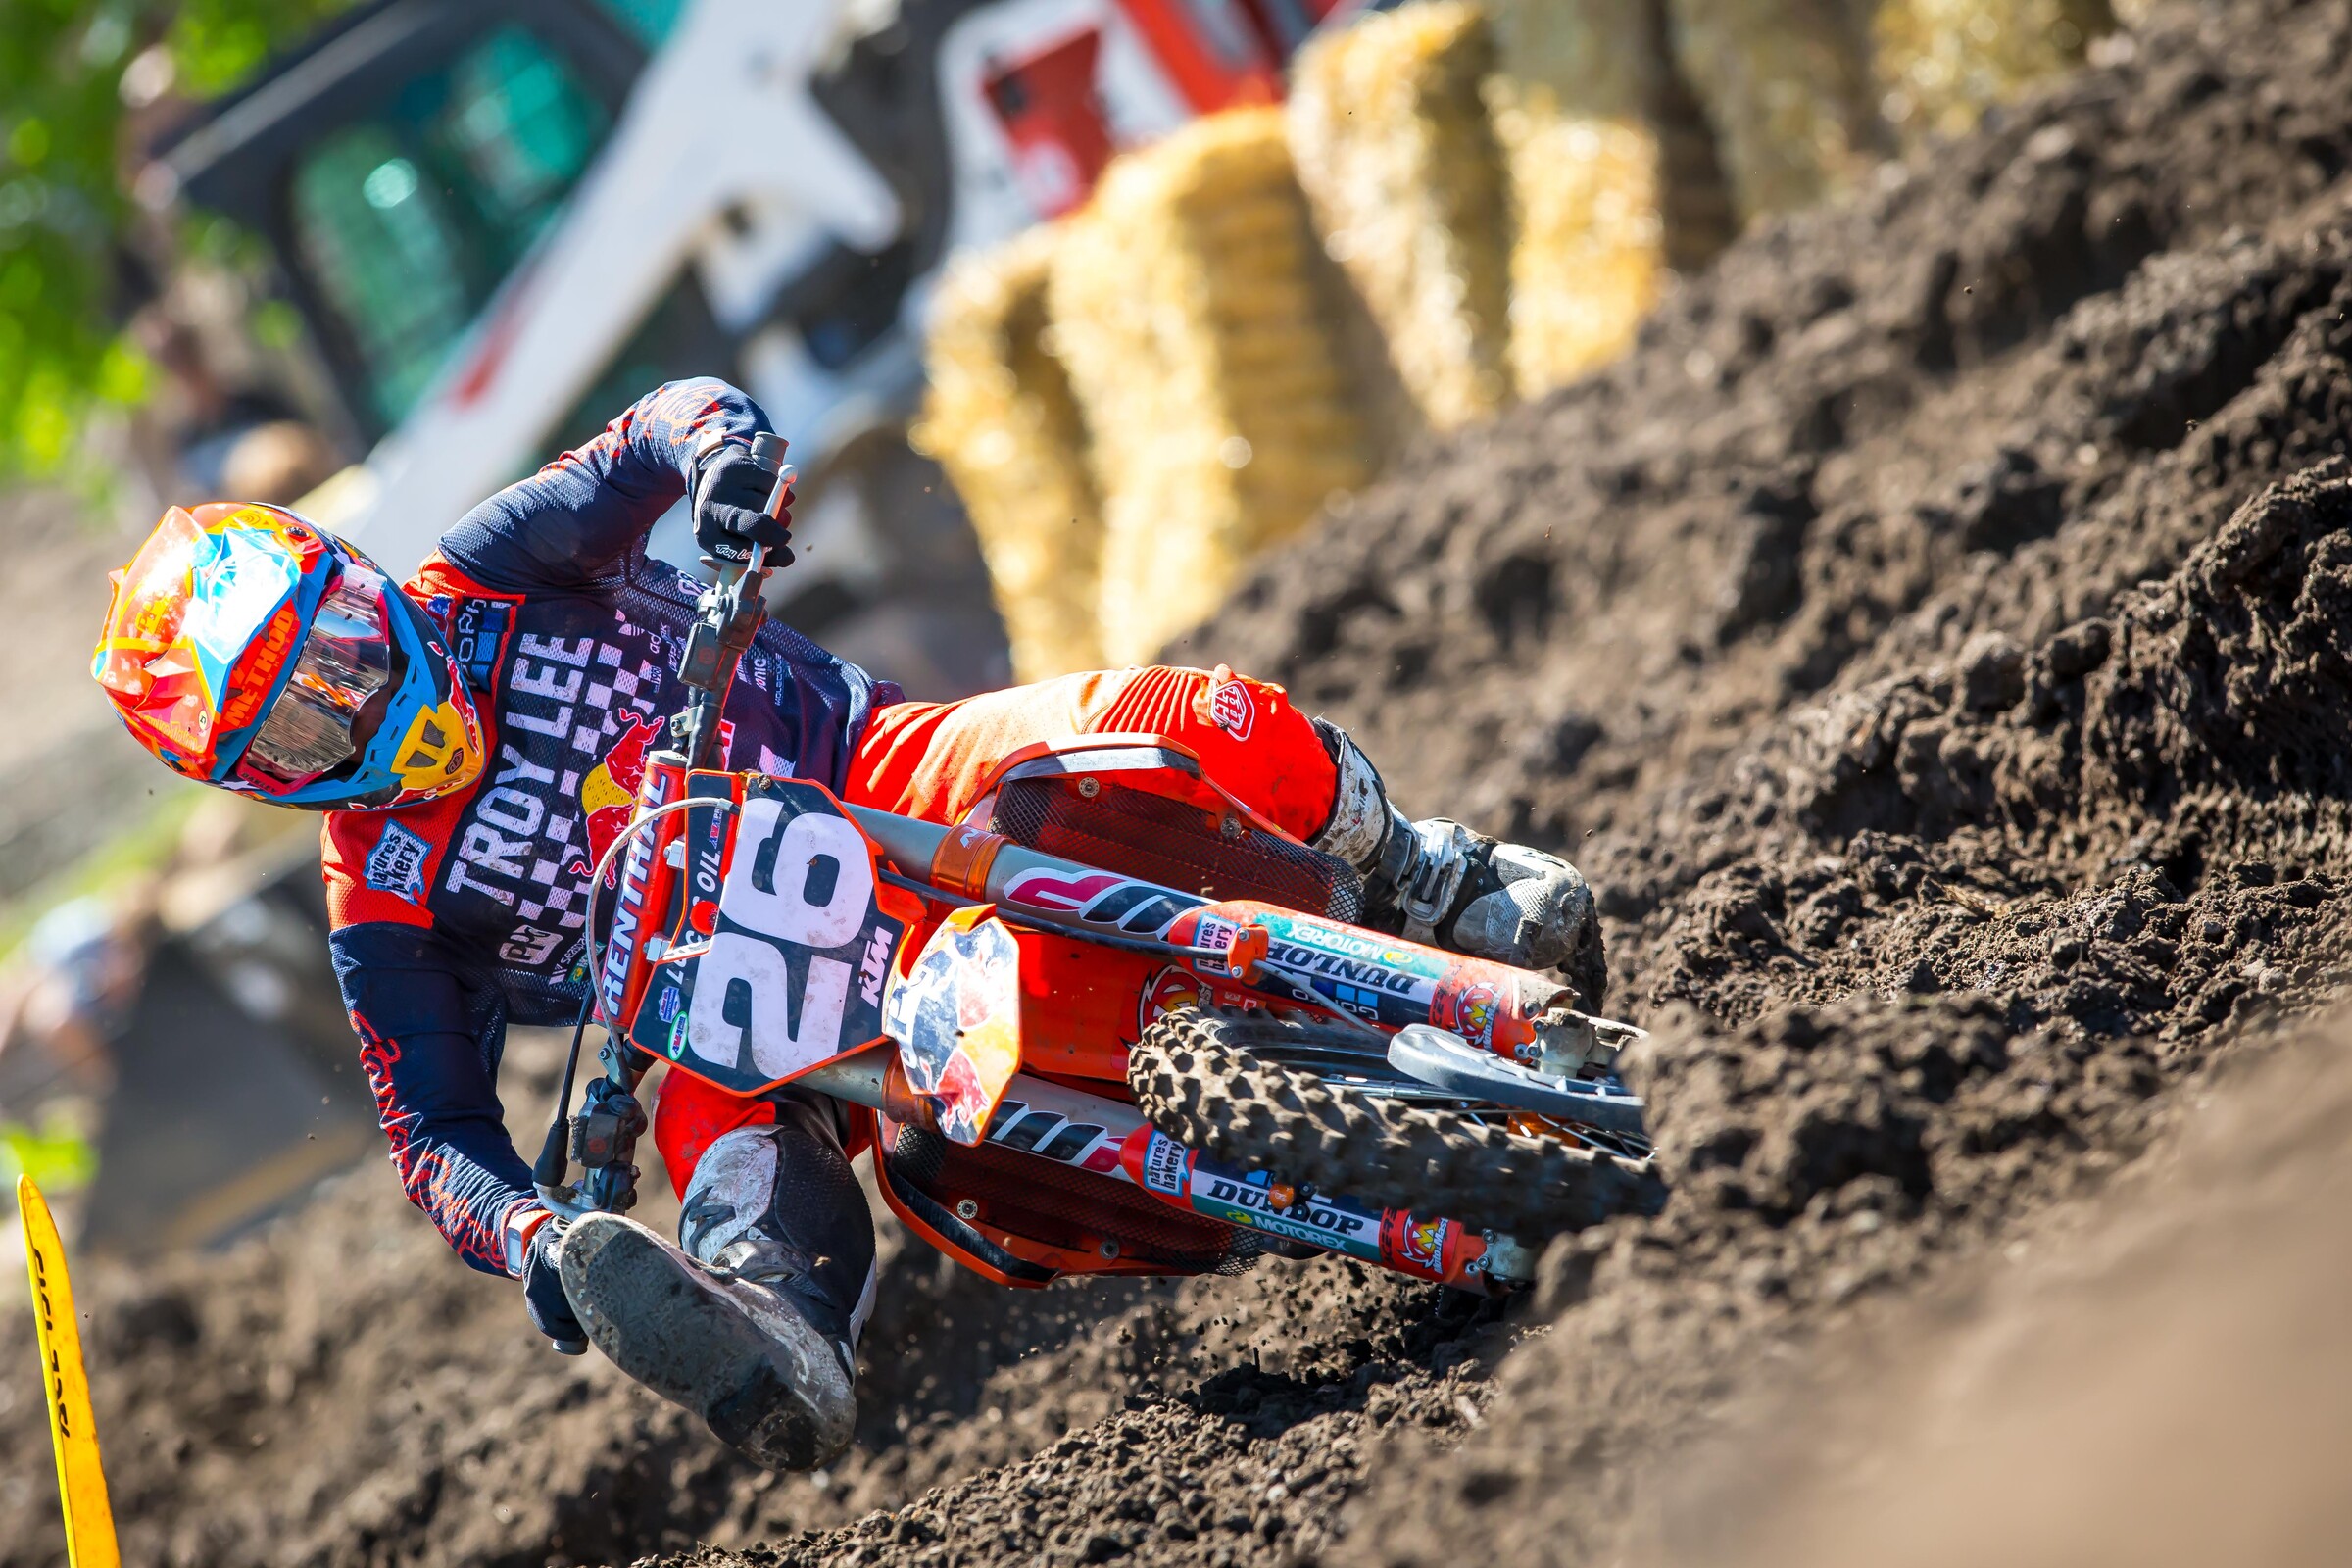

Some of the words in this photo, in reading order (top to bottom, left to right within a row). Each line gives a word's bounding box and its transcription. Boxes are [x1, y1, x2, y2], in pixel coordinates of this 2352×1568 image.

[715, 545, 737, 559] Troy
[223, 609, 294, 727] METHOD
[446, 744, 555, 906] TROY
[506, 633, 594, 740] LEE
[603, 773, 667, 1016] RENTHAL
[697, 851, 721, 893] OIL
[689, 798, 873, 1079] 26
[859, 926, 894, 1008] KTM
[1286, 922, 1385, 960] MOTOREX
[1160, 1142, 1185, 1190] bakery
[1254, 1215, 1349, 1252] MOTOREX
